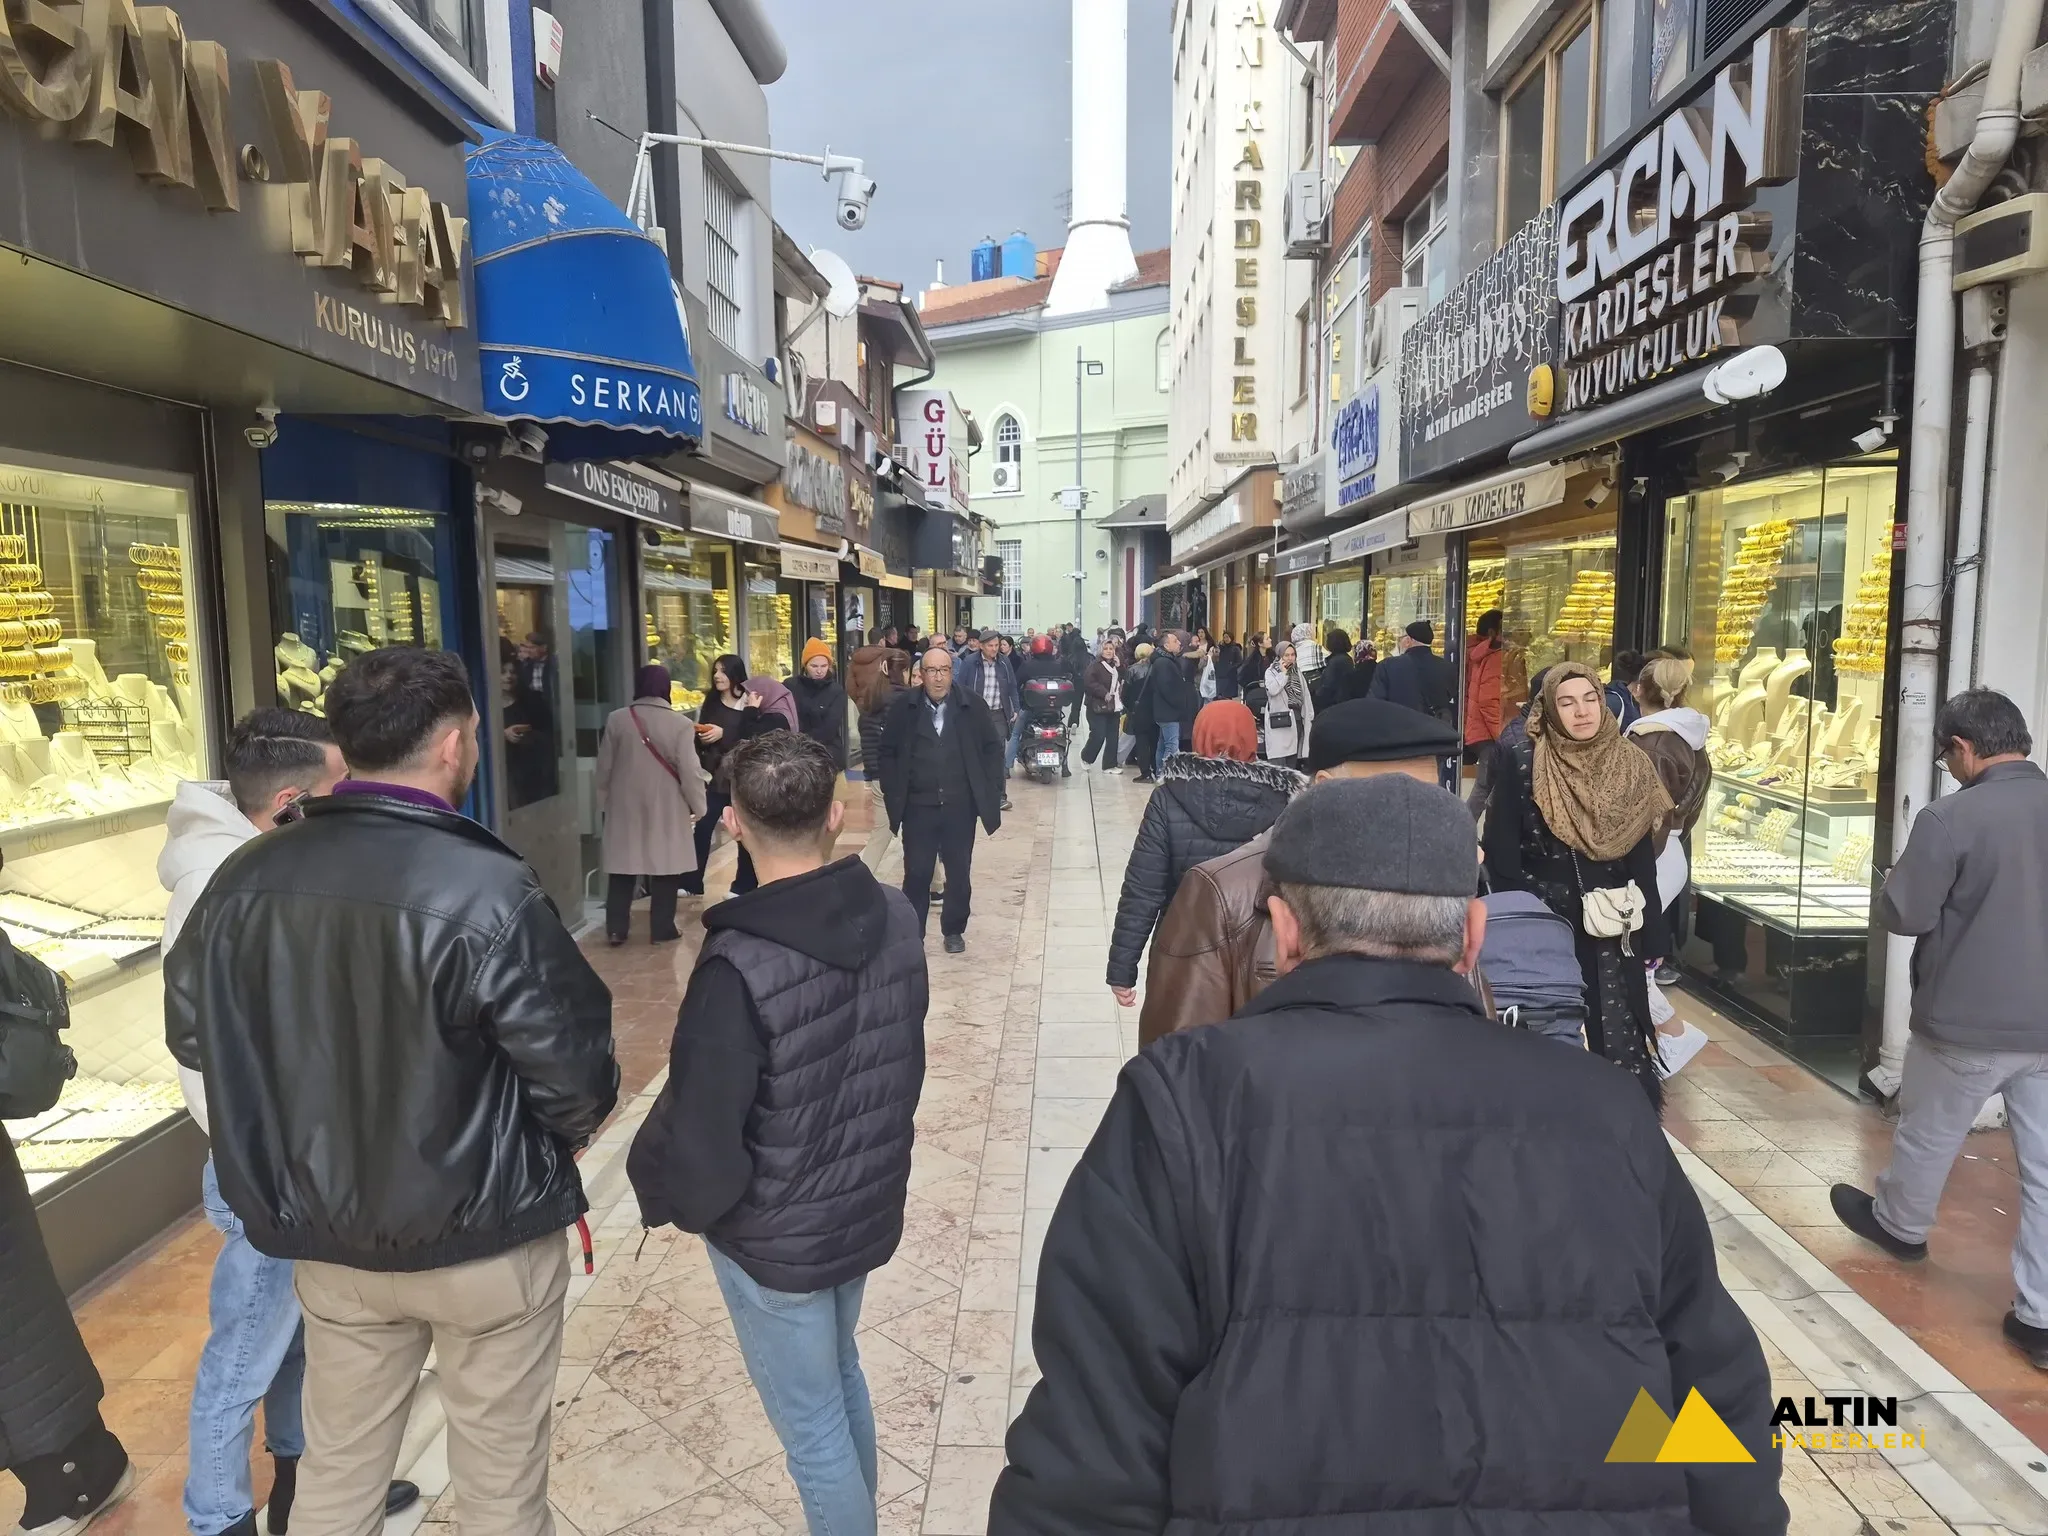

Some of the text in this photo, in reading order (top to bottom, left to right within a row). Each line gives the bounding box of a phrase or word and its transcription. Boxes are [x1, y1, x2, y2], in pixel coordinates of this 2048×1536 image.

[1557, 28, 1774, 304] ERCAN
[1563, 211, 1740, 361] KARDEŞLER
[313, 291, 458, 382] KURULUŞ 1970
[1566, 296, 1729, 411] KUYUMCULUK
[923, 399, 946, 486] GÜL
[1451, 381, 1513, 428] KARDEŞLER
[611, 473, 660, 514] ESKİŞEHİR
